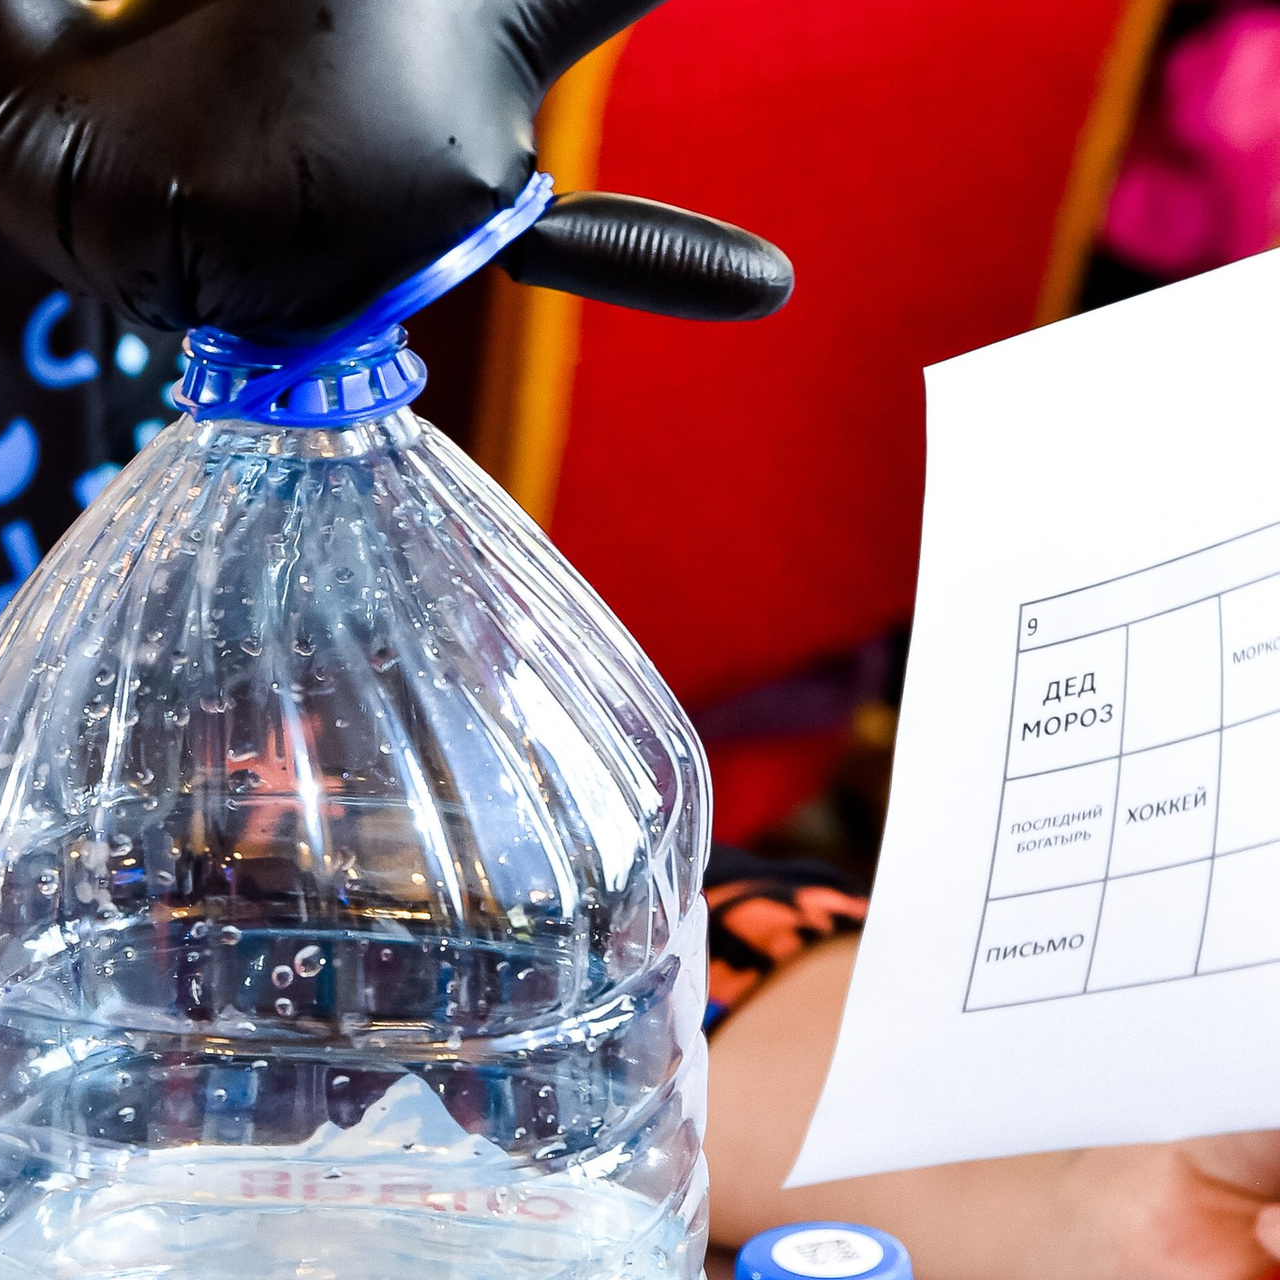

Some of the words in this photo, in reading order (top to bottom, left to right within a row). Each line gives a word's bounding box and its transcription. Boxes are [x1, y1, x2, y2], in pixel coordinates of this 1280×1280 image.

[1026, 617, 1038, 637] 9
[1042, 672, 1097, 706] ДЕД
[1021, 703, 1114, 742] МОРОЗ
[1010, 804, 1104, 835] ПОСЛЕДНИЙ
[1126, 786, 1208, 825] ХОККЕЙ
[1016, 830, 1092, 854] БОГАТЫРЬ
[985, 933, 1085, 963] ПИСЬМО
